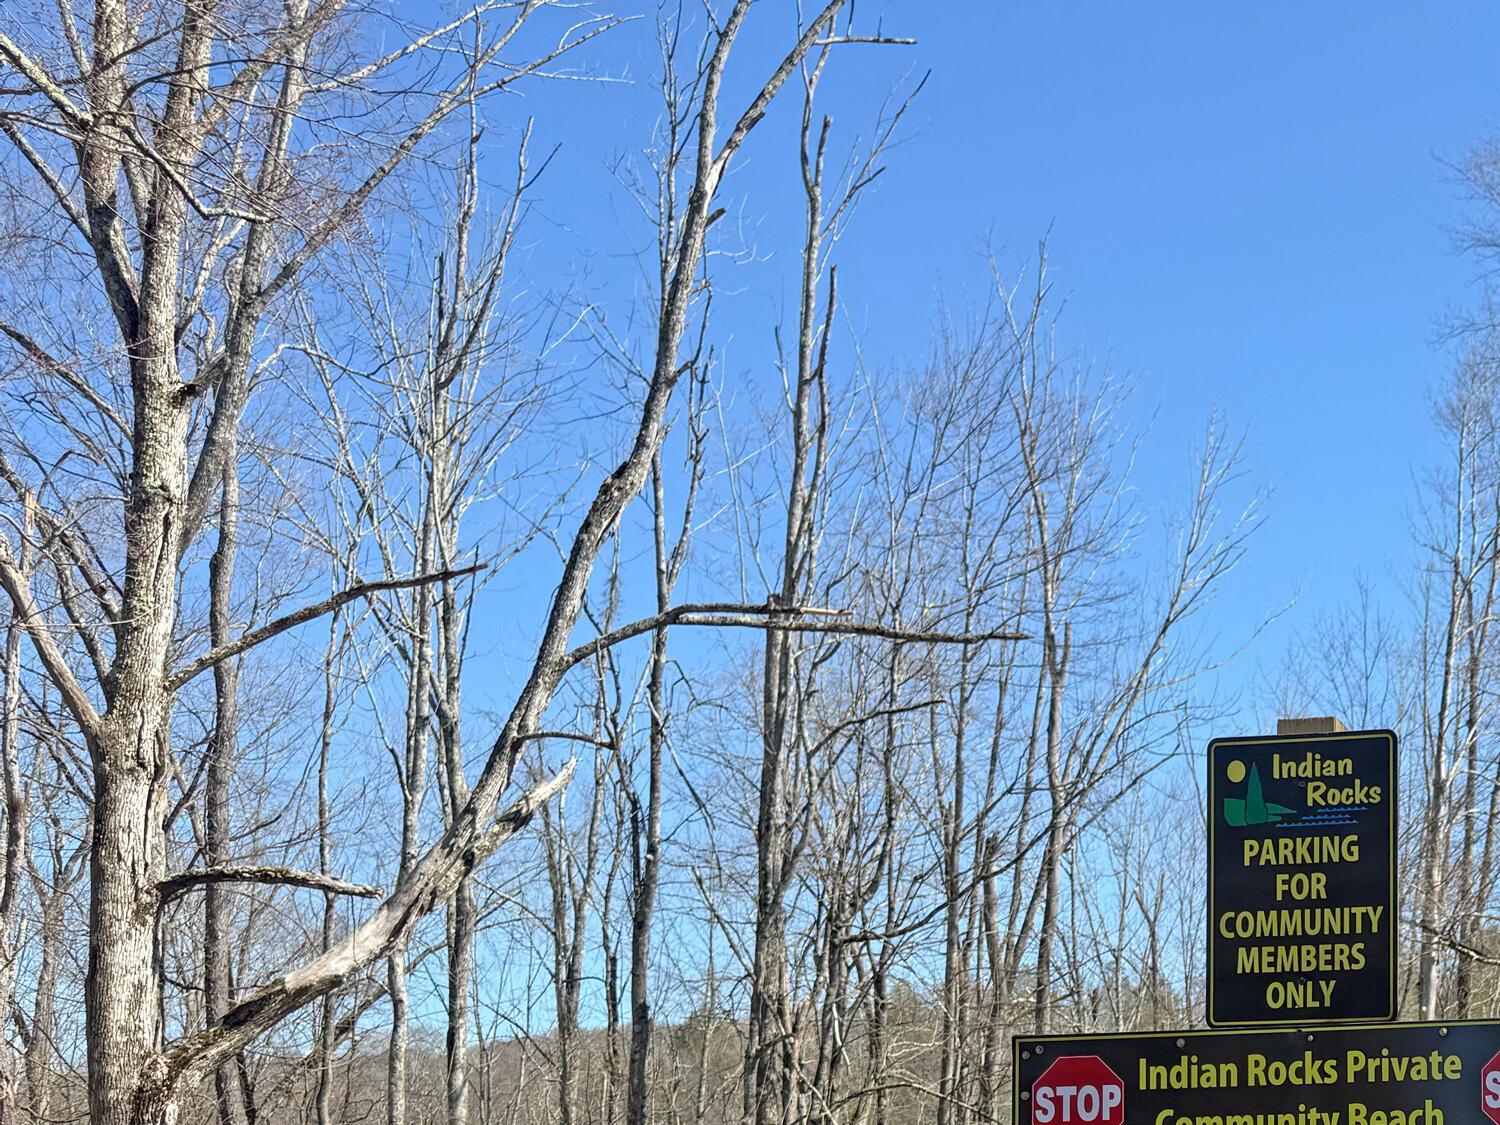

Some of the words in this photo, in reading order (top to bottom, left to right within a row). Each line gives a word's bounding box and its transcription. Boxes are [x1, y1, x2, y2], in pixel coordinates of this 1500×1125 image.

[1273, 752, 1352, 779] Indian
[1307, 779, 1381, 806] Rocks
[1244, 835, 1358, 866] PARKING
[1277, 873, 1326, 900] FOR
[1220, 906, 1383, 938] COMMUNITY
[1237, 943, 1365, 973] MEMBERS
[1267, 980, 1336, 1008] ONLY
[1140, 1055, 1237, 1090] Indian
[1248, 1051, 1337, 1086] Rocks
[1347, 1049, 1461, 1082] Private
[1035, 1085, 1121, 1123] STOP
